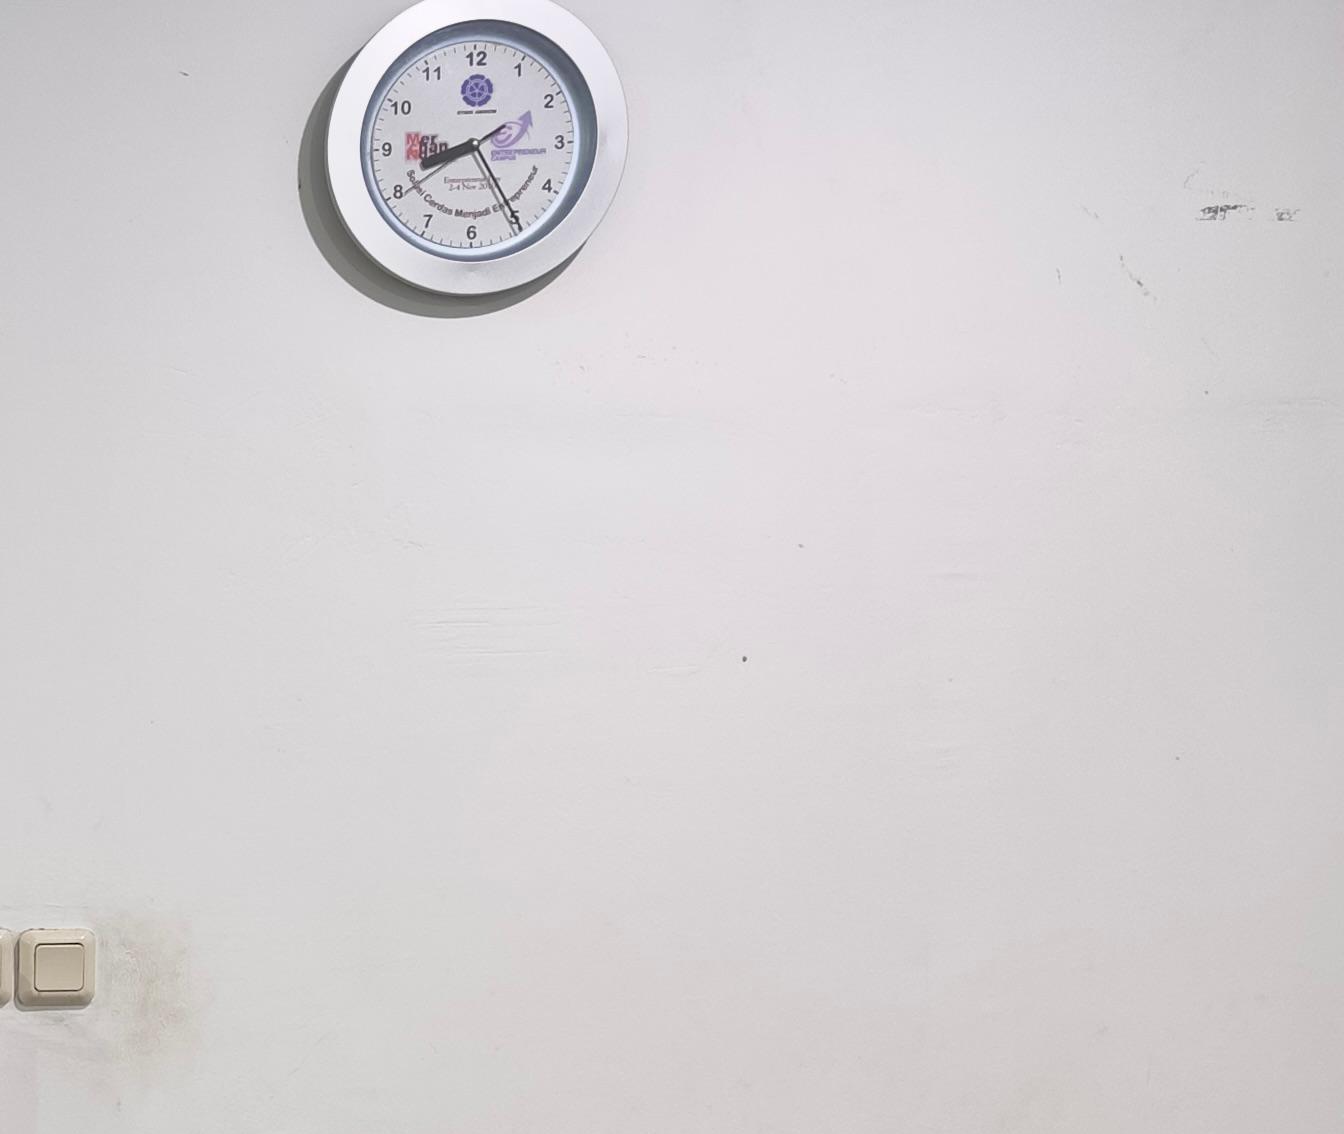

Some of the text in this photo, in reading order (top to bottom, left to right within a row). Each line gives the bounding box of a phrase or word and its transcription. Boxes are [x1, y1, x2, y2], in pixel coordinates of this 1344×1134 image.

[466, 51, 487, 67] 12
[422, 66, 442, 81] 11
[514, 63, 522, 78] 1
[391, 100, 412, 115] 10
[544, 94, 554, 109] 2
[381, 142, 392, 157] 9
[554, 135, 565, 150] 3
[393, 184, 404, 199] 8
[541, 179, 553, 194] 4
[423, 214, 433, 229] 7
[510, 210, 520, 225] 5
[466, 225, 477, 240] 6
